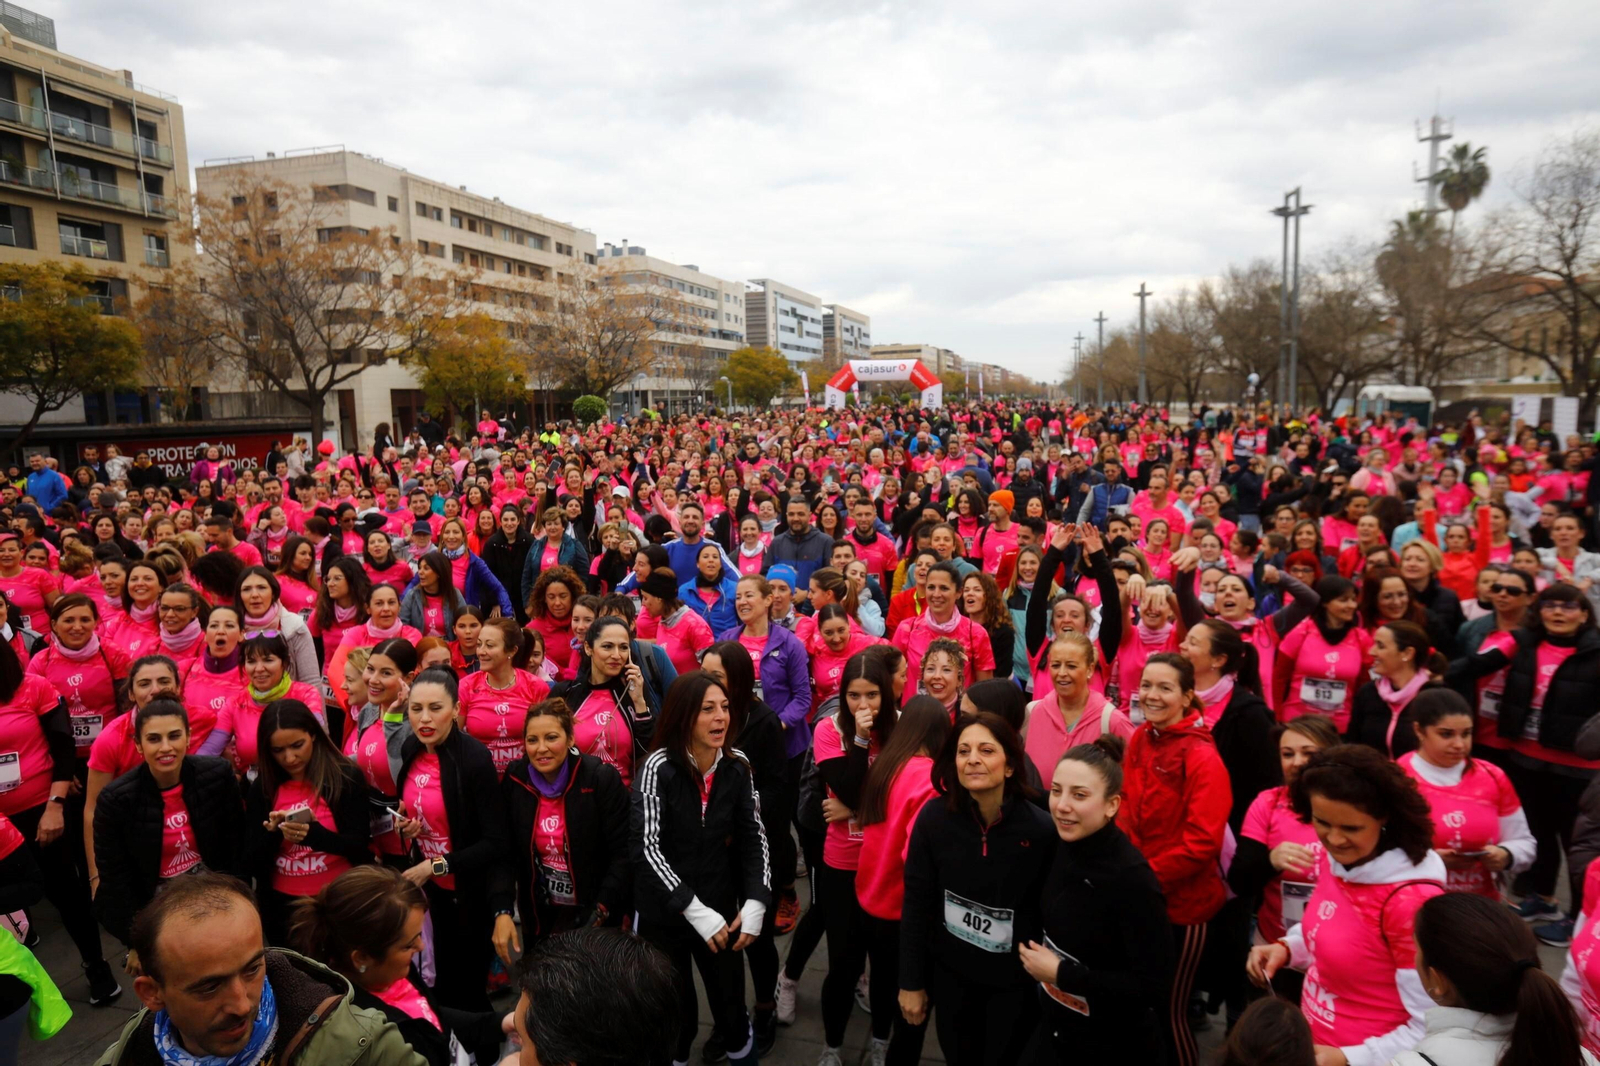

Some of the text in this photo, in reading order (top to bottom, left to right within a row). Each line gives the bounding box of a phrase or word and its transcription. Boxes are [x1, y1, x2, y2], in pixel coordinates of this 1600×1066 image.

[858, 365, 897, 375] cajasur
[73, 725, 90, 736] 53
[490, 746, 524, 760] INK
[276, 855, 328, 872] PINK
[963, 911, 992, 935] 402
